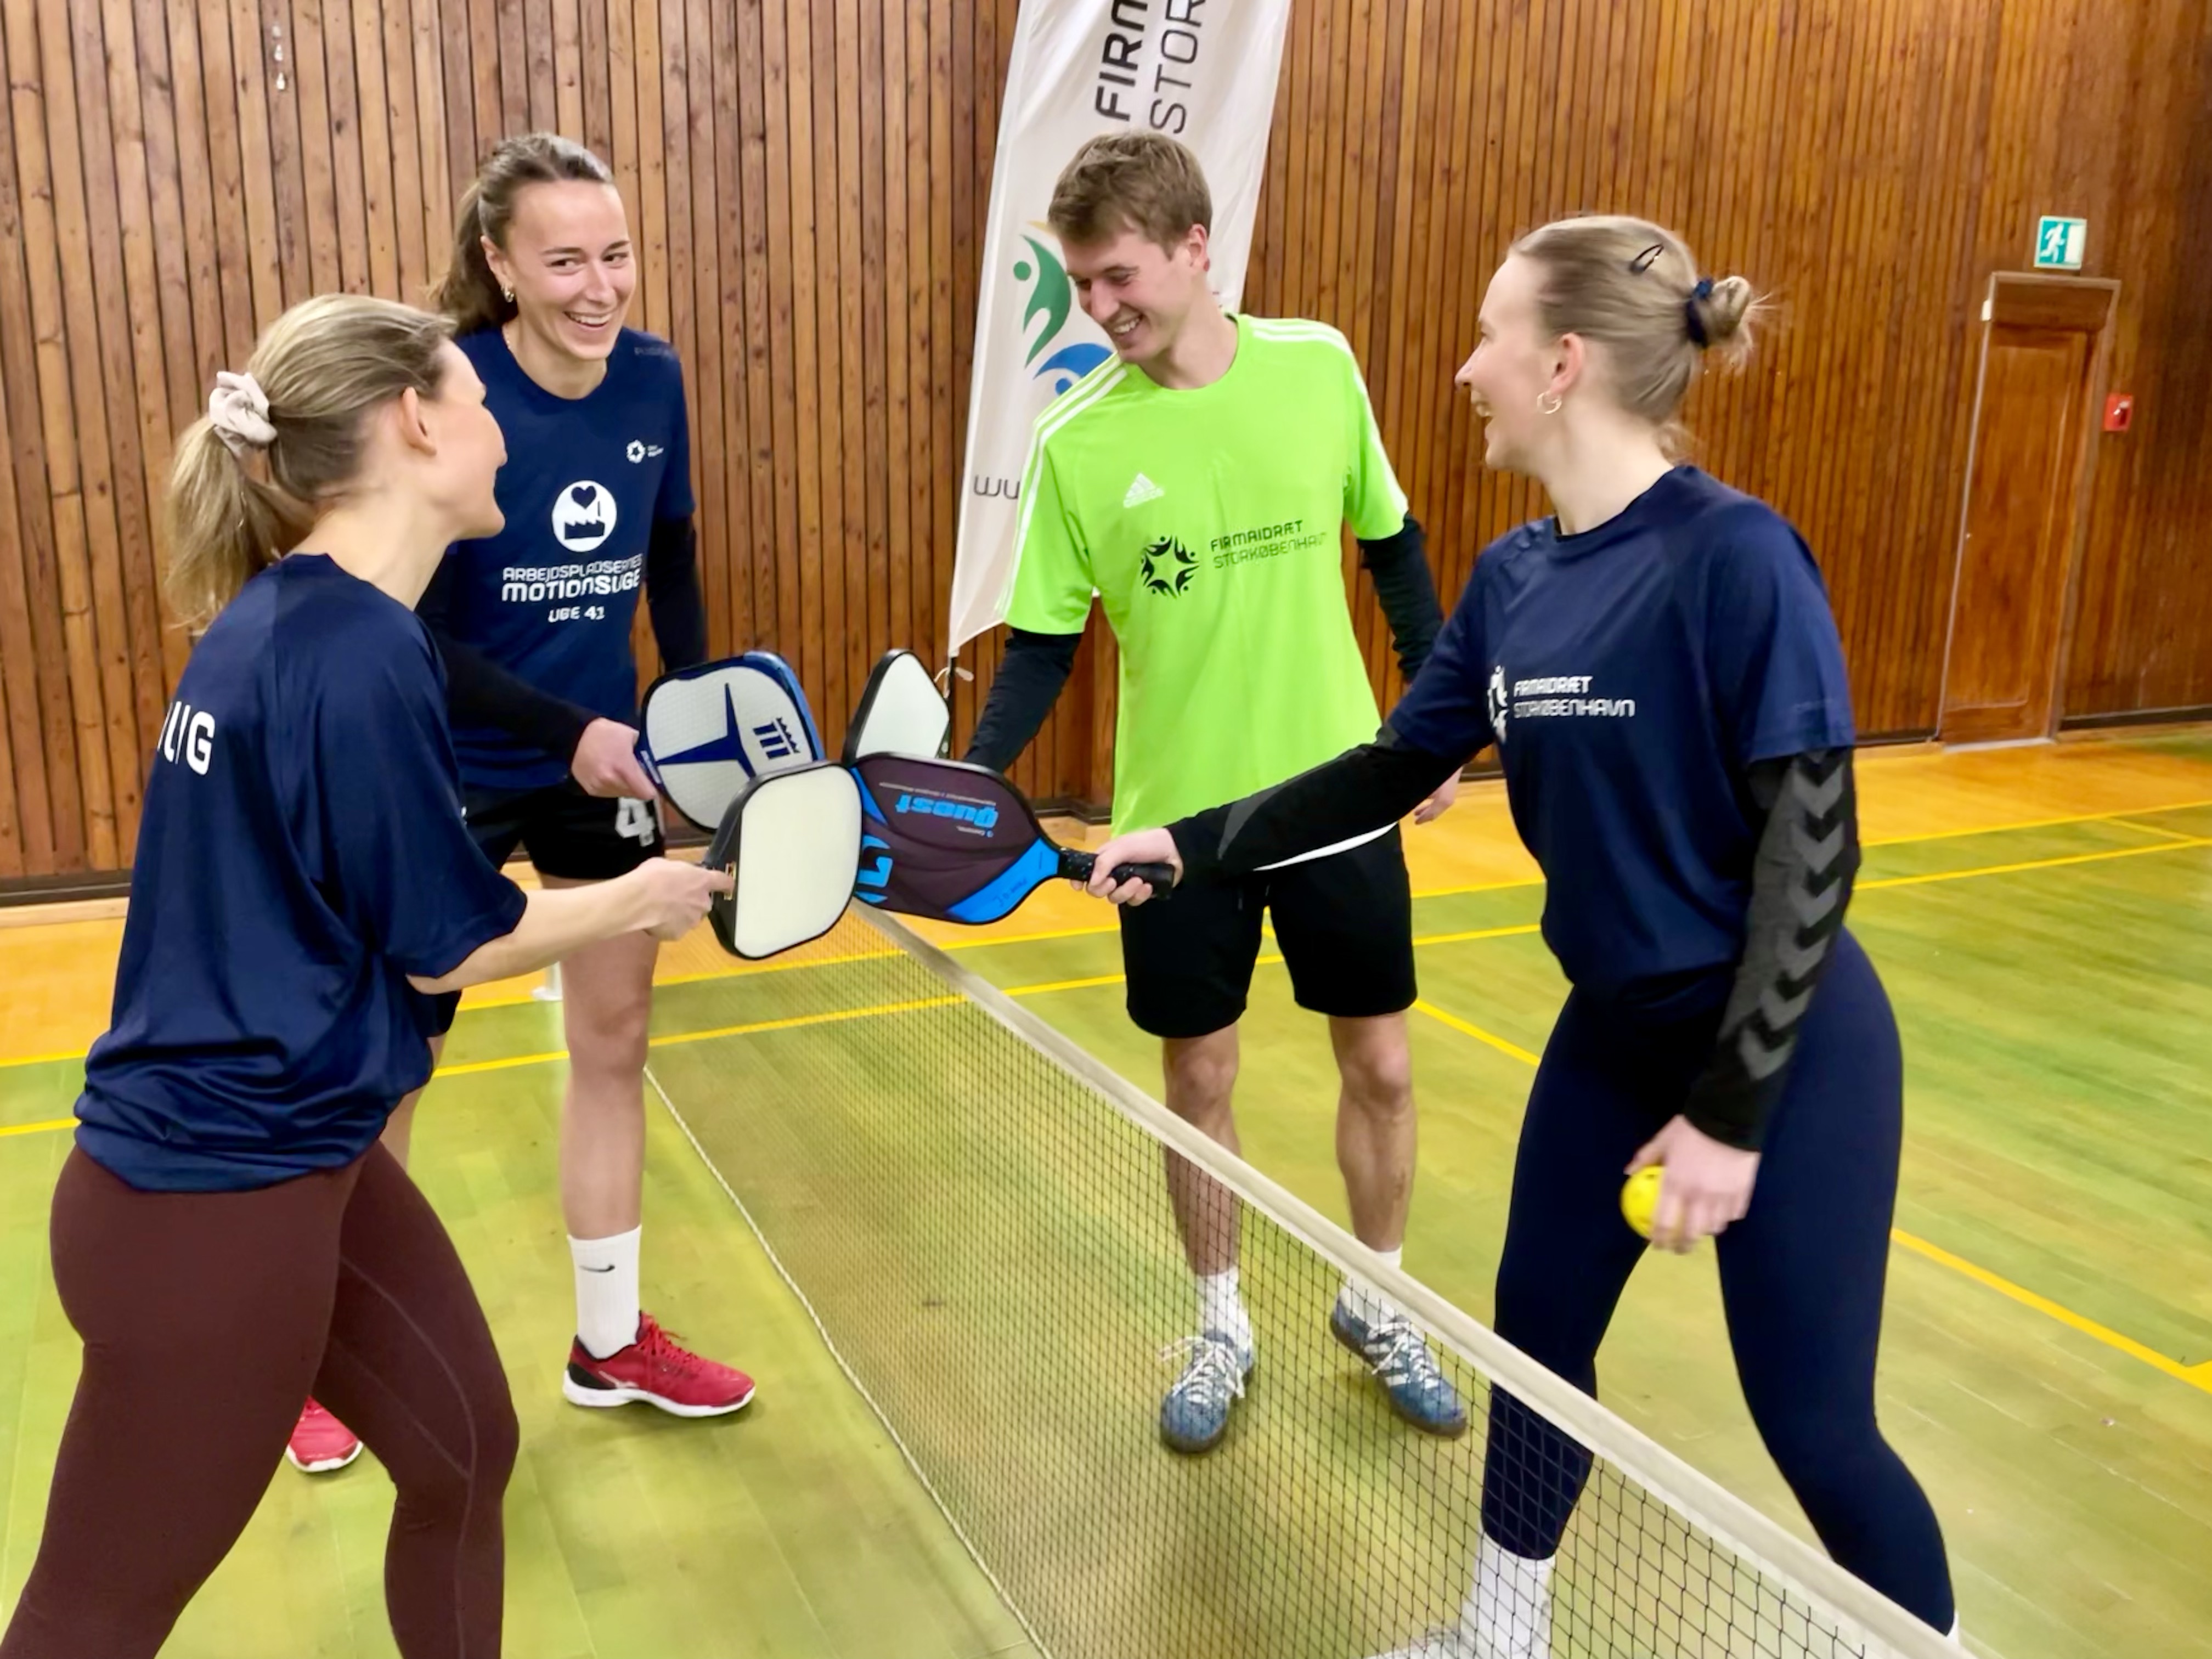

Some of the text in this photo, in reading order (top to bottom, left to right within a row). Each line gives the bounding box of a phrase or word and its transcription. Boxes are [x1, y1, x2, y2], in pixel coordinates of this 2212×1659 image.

[548, 606, 605, 623] UGE 41
[615, 797, 655, 847] 4
